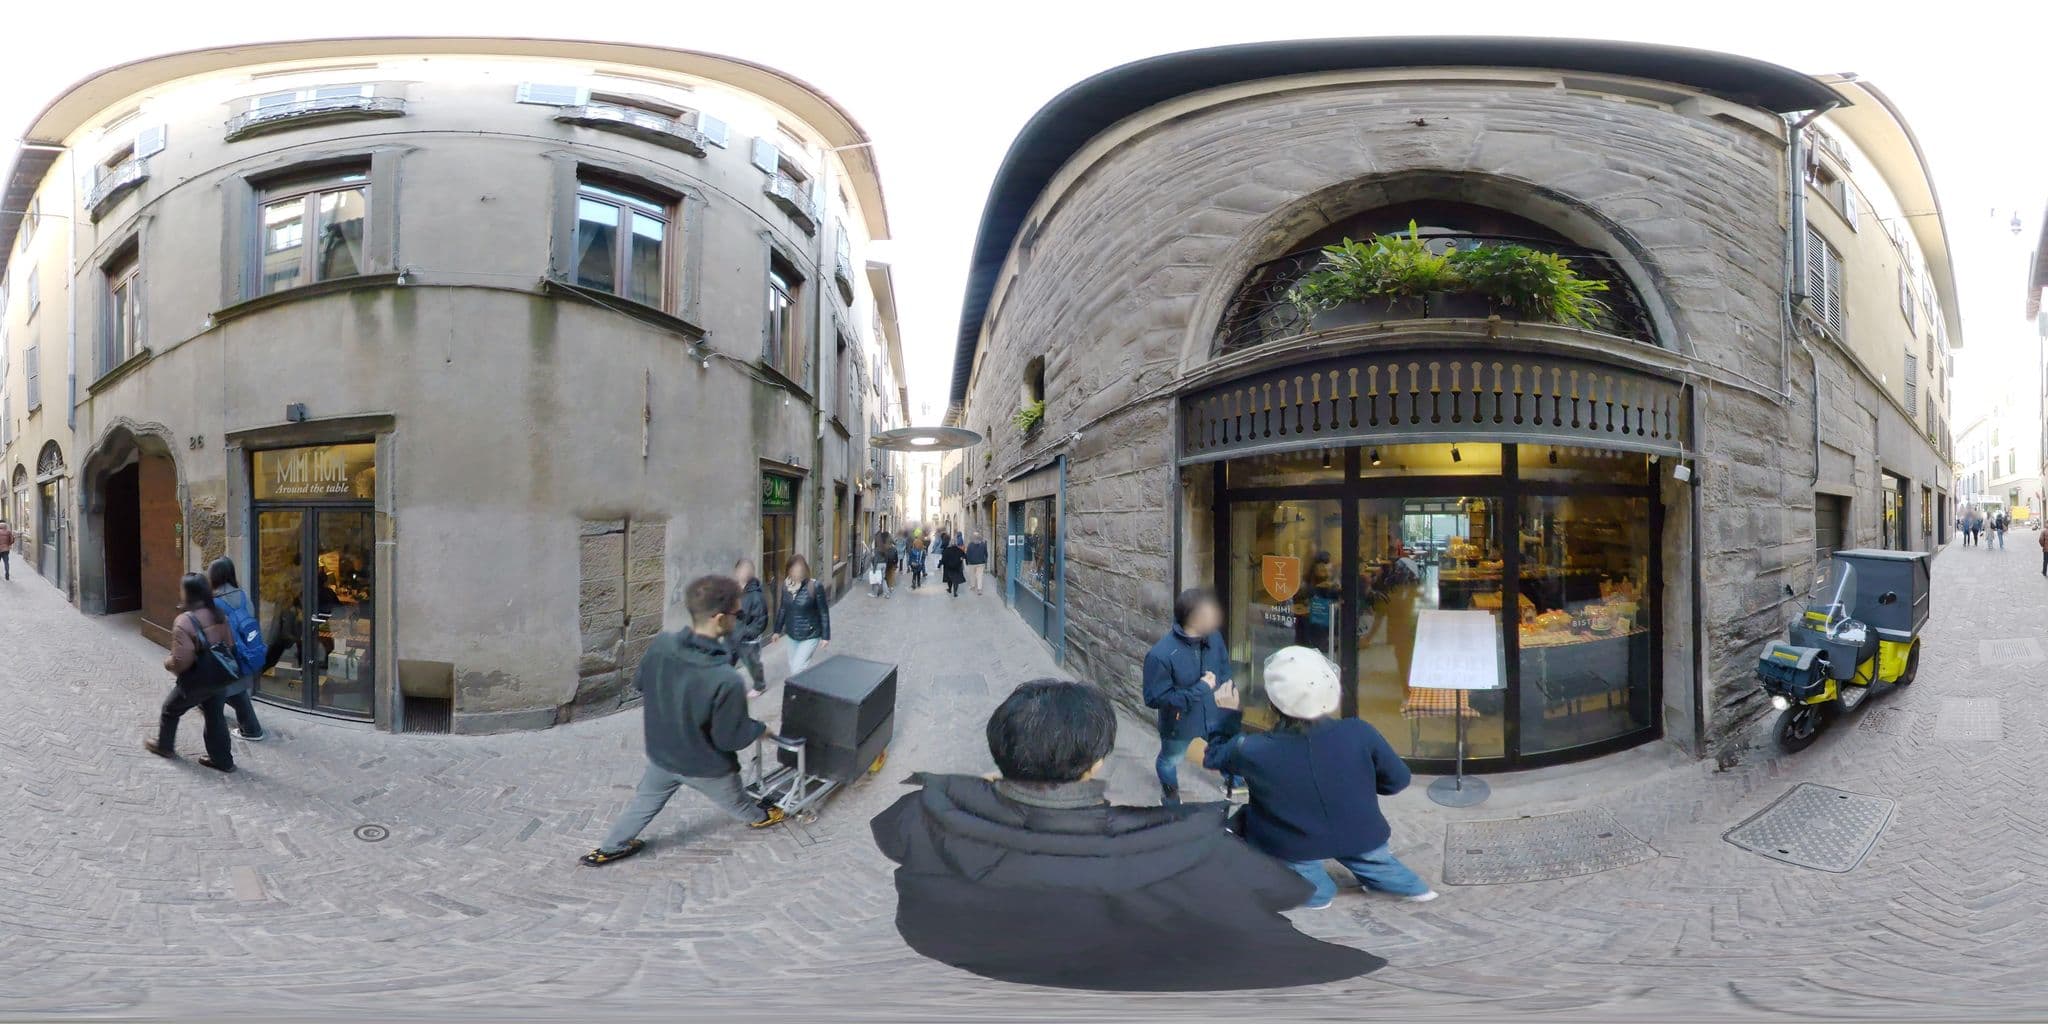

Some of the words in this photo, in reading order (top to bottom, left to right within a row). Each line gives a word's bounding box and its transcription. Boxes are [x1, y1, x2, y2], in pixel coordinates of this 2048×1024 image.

[189, 435, 205, 450] 26
[277, 452, 308, 484] MIMI
[314, 451, 348, 482] HOME
[275, 483, 309, 494] Around
[310, 484, 325, 493] the
[326, 482, 349, 493] table
[1271, 605, 1291, 614] MIMI
[1264, 612, 1297, 624] BISTROT
